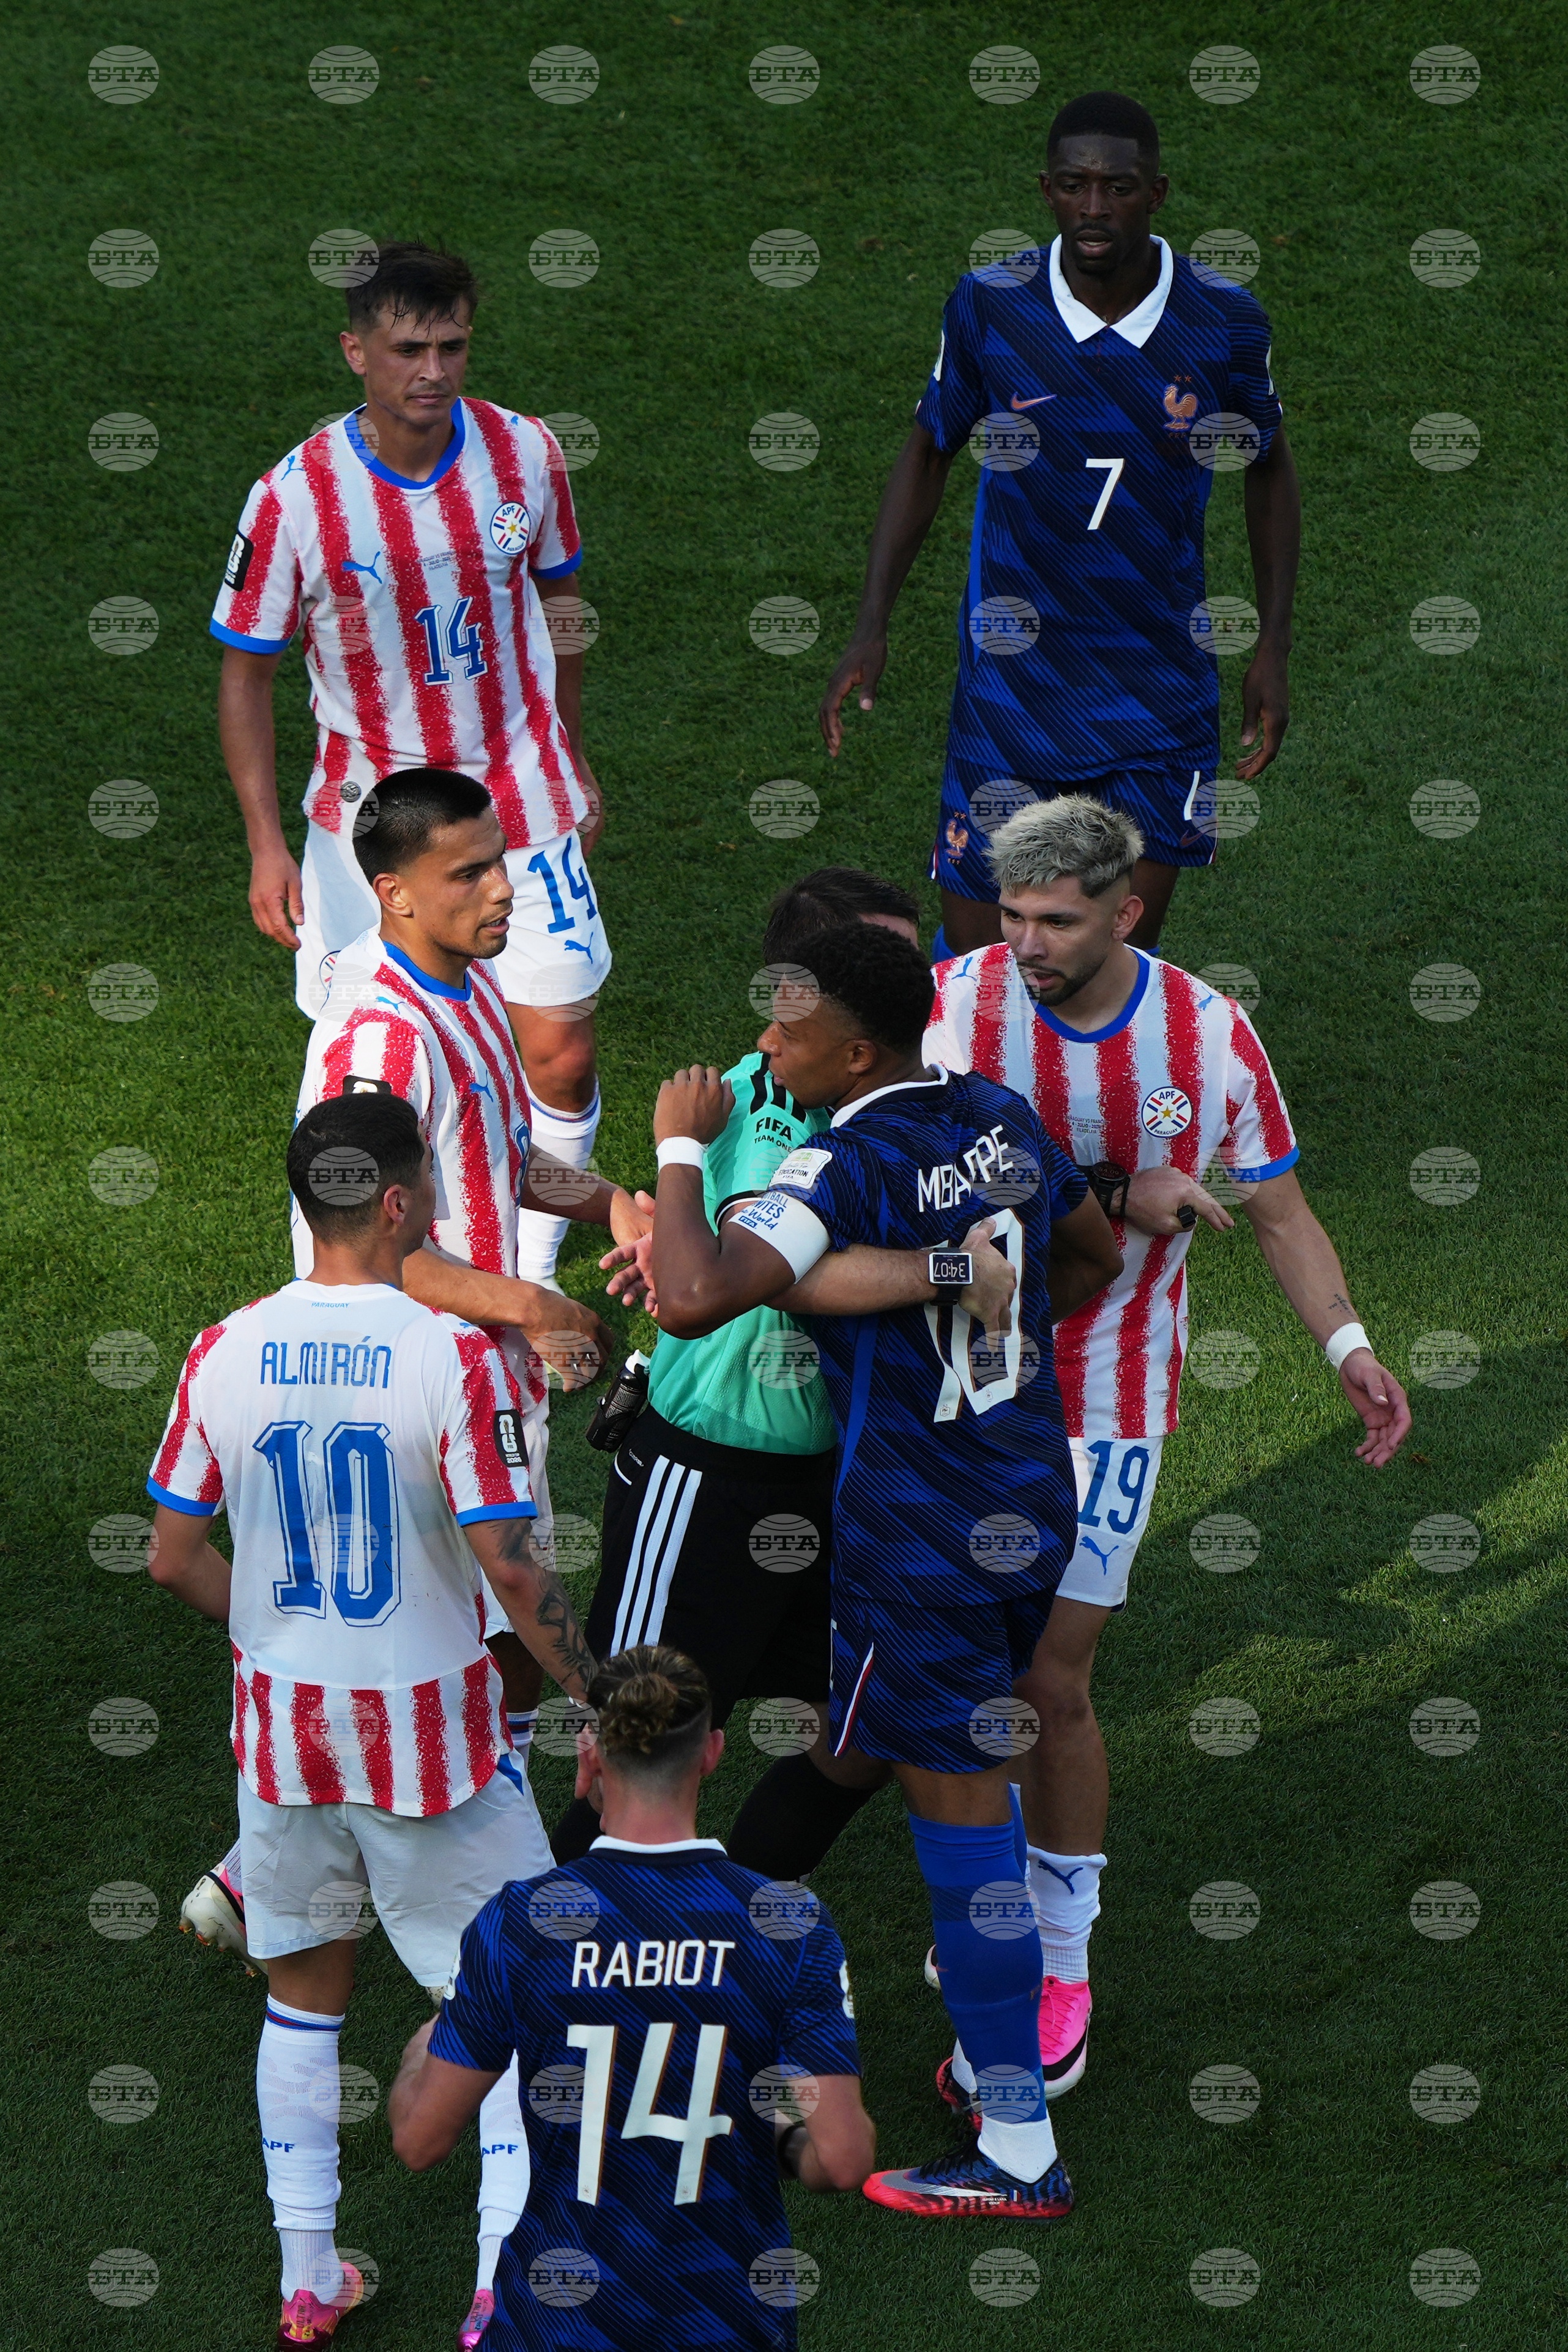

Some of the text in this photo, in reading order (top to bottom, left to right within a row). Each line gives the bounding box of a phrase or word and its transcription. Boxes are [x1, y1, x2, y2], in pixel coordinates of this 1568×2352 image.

[1085, 458, 1126, 530] 7
[502, 505, 515, 516] APF
[414, 596, 488, 685] 14
[527, 836, 598, 934] 14
[1159, 1091, 1175, 1100] APF
[756, 1117, 792, 1142] FIFA
[754, 1134, 793, 1153] TEAM ONE
[752, 1199, 784, 1219] NITES
[763, 1191, 789, 1208] OTBALL
[739, 1216, 756, 1228] FIFA
[748, 1208, 779, 1230] World
[934, 1262, 966, 1278] 34:07
[260, 1336, 392, 1390] ALMIRÓN
[1077, 1440, 1150, 1535] 19
[251, 1420, 402, 1628] 10
[572, 1940, 737, 1989] RABIOT
[566, 2022, 734, 2207] 14
[262, 2137, 295, 2153] APF
[481, 2143, 518, 2159] APF
